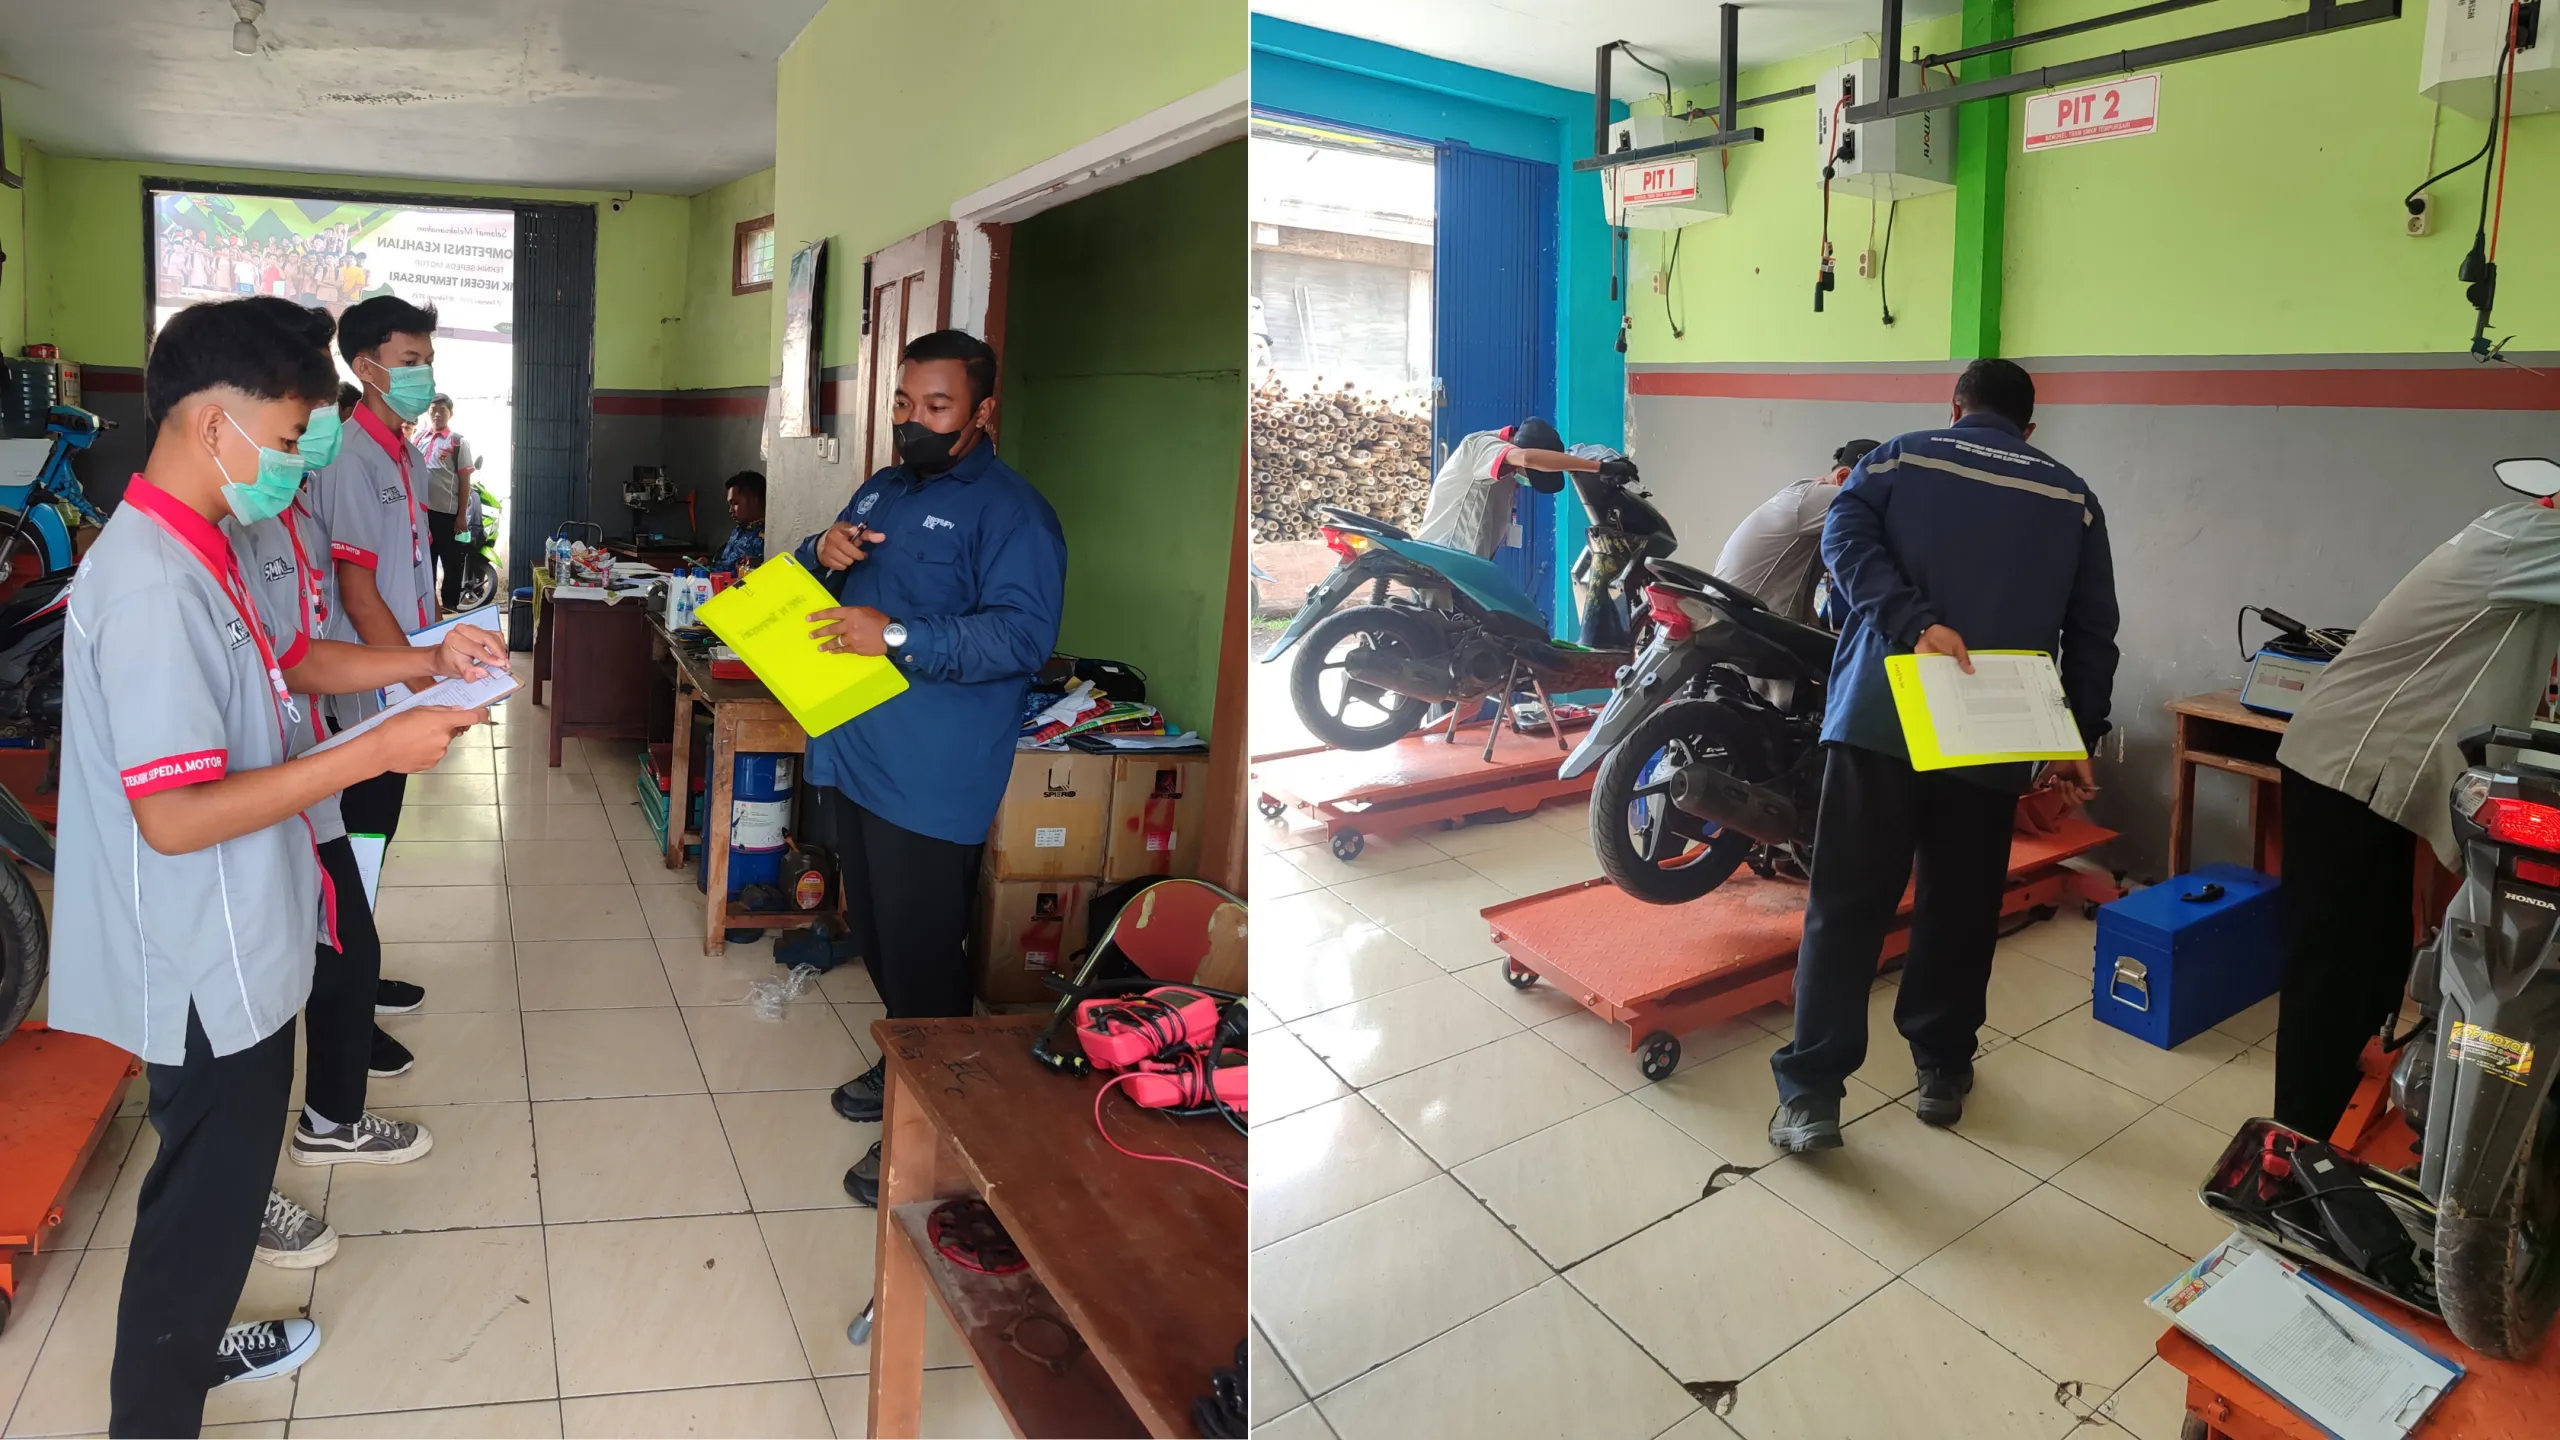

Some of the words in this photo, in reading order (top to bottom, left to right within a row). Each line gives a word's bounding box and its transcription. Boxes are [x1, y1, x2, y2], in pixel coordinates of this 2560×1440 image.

[2057, 94, 2096, 128] PIT
[2103, 89, 2120, 120] 2
[2045, 132, 2068, 142] BENGKEL
[2098, 122, 2131, 134] TEMPURSARI
[1643, 169, 1665, 190] PIT
[1669, 168, 1674, 188] 1
[331, 542, 346, 550] PEDA
[346, 545, 360, 556] MOTOR
[123, 772, 150, 788] TEKNIK
[148, 764, 184, 780] SEPEDA
[184, 756, 222, 772] MOTOR
[2504, 891, 2556, 910] HONDA
[2479, 1030, 2530, 1055] MOTOR
